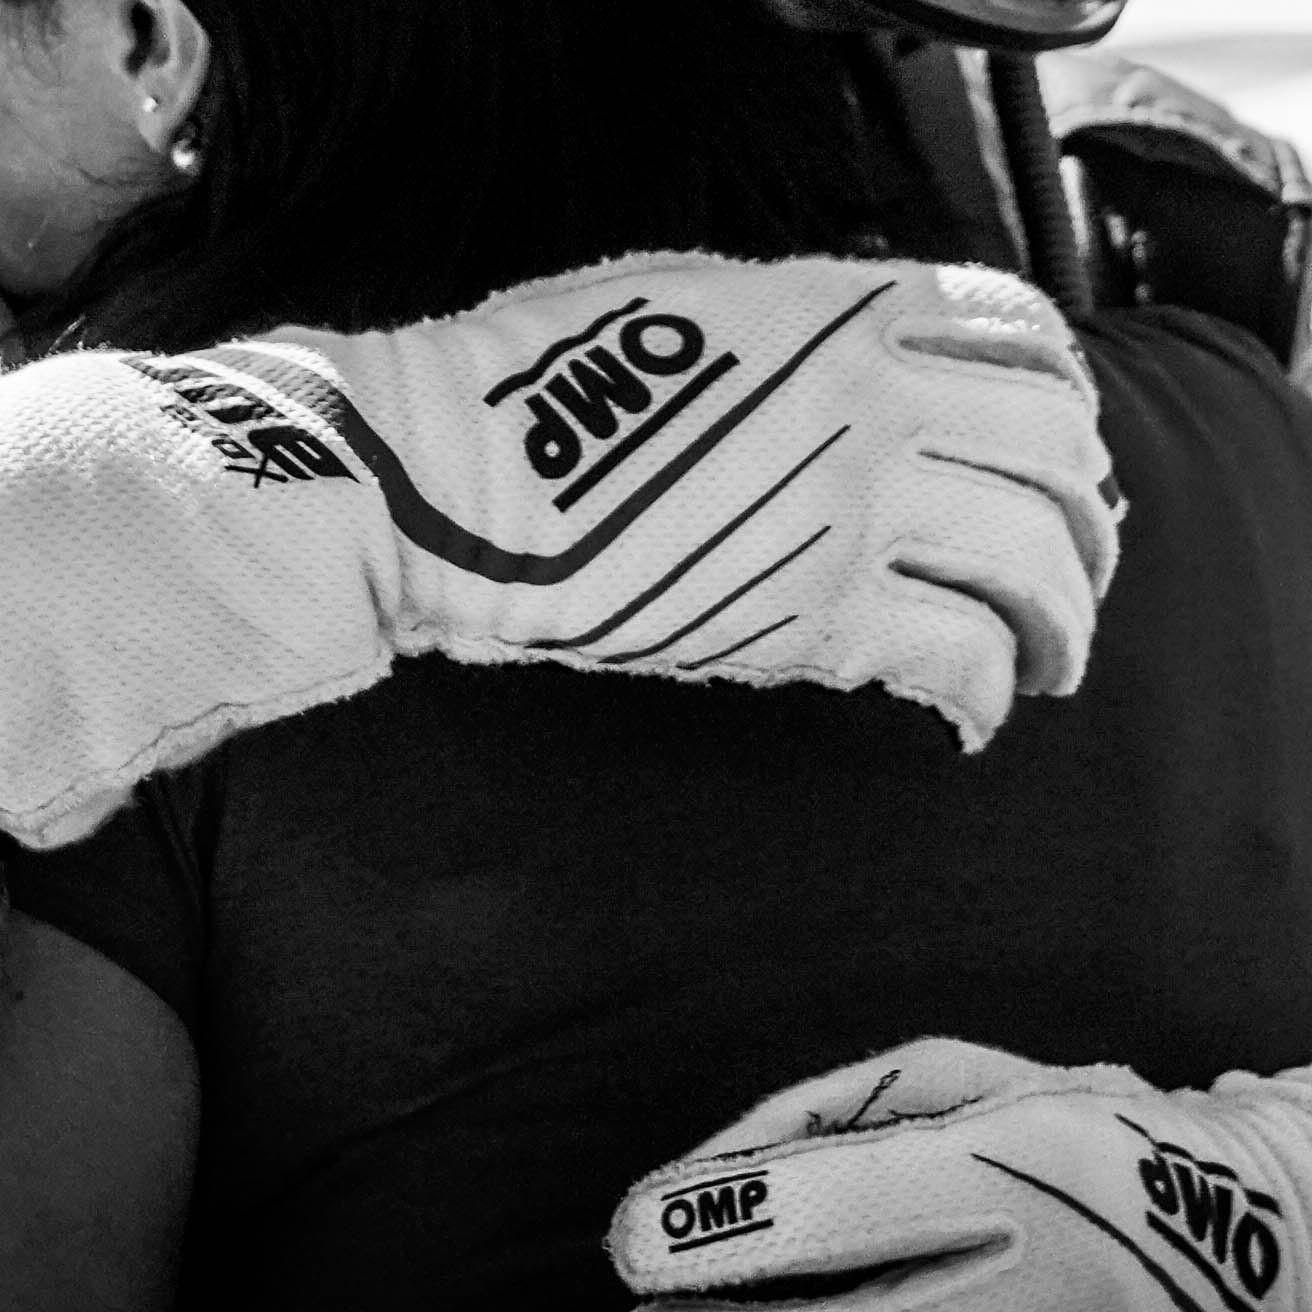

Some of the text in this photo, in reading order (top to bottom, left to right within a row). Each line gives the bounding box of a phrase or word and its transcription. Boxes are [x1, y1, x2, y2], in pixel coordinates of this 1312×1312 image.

[523, 313, 706, 480] OMP
[660, 1178, 769, 1240] OMP
[1137, 1152, 1281, 1302] OMP
